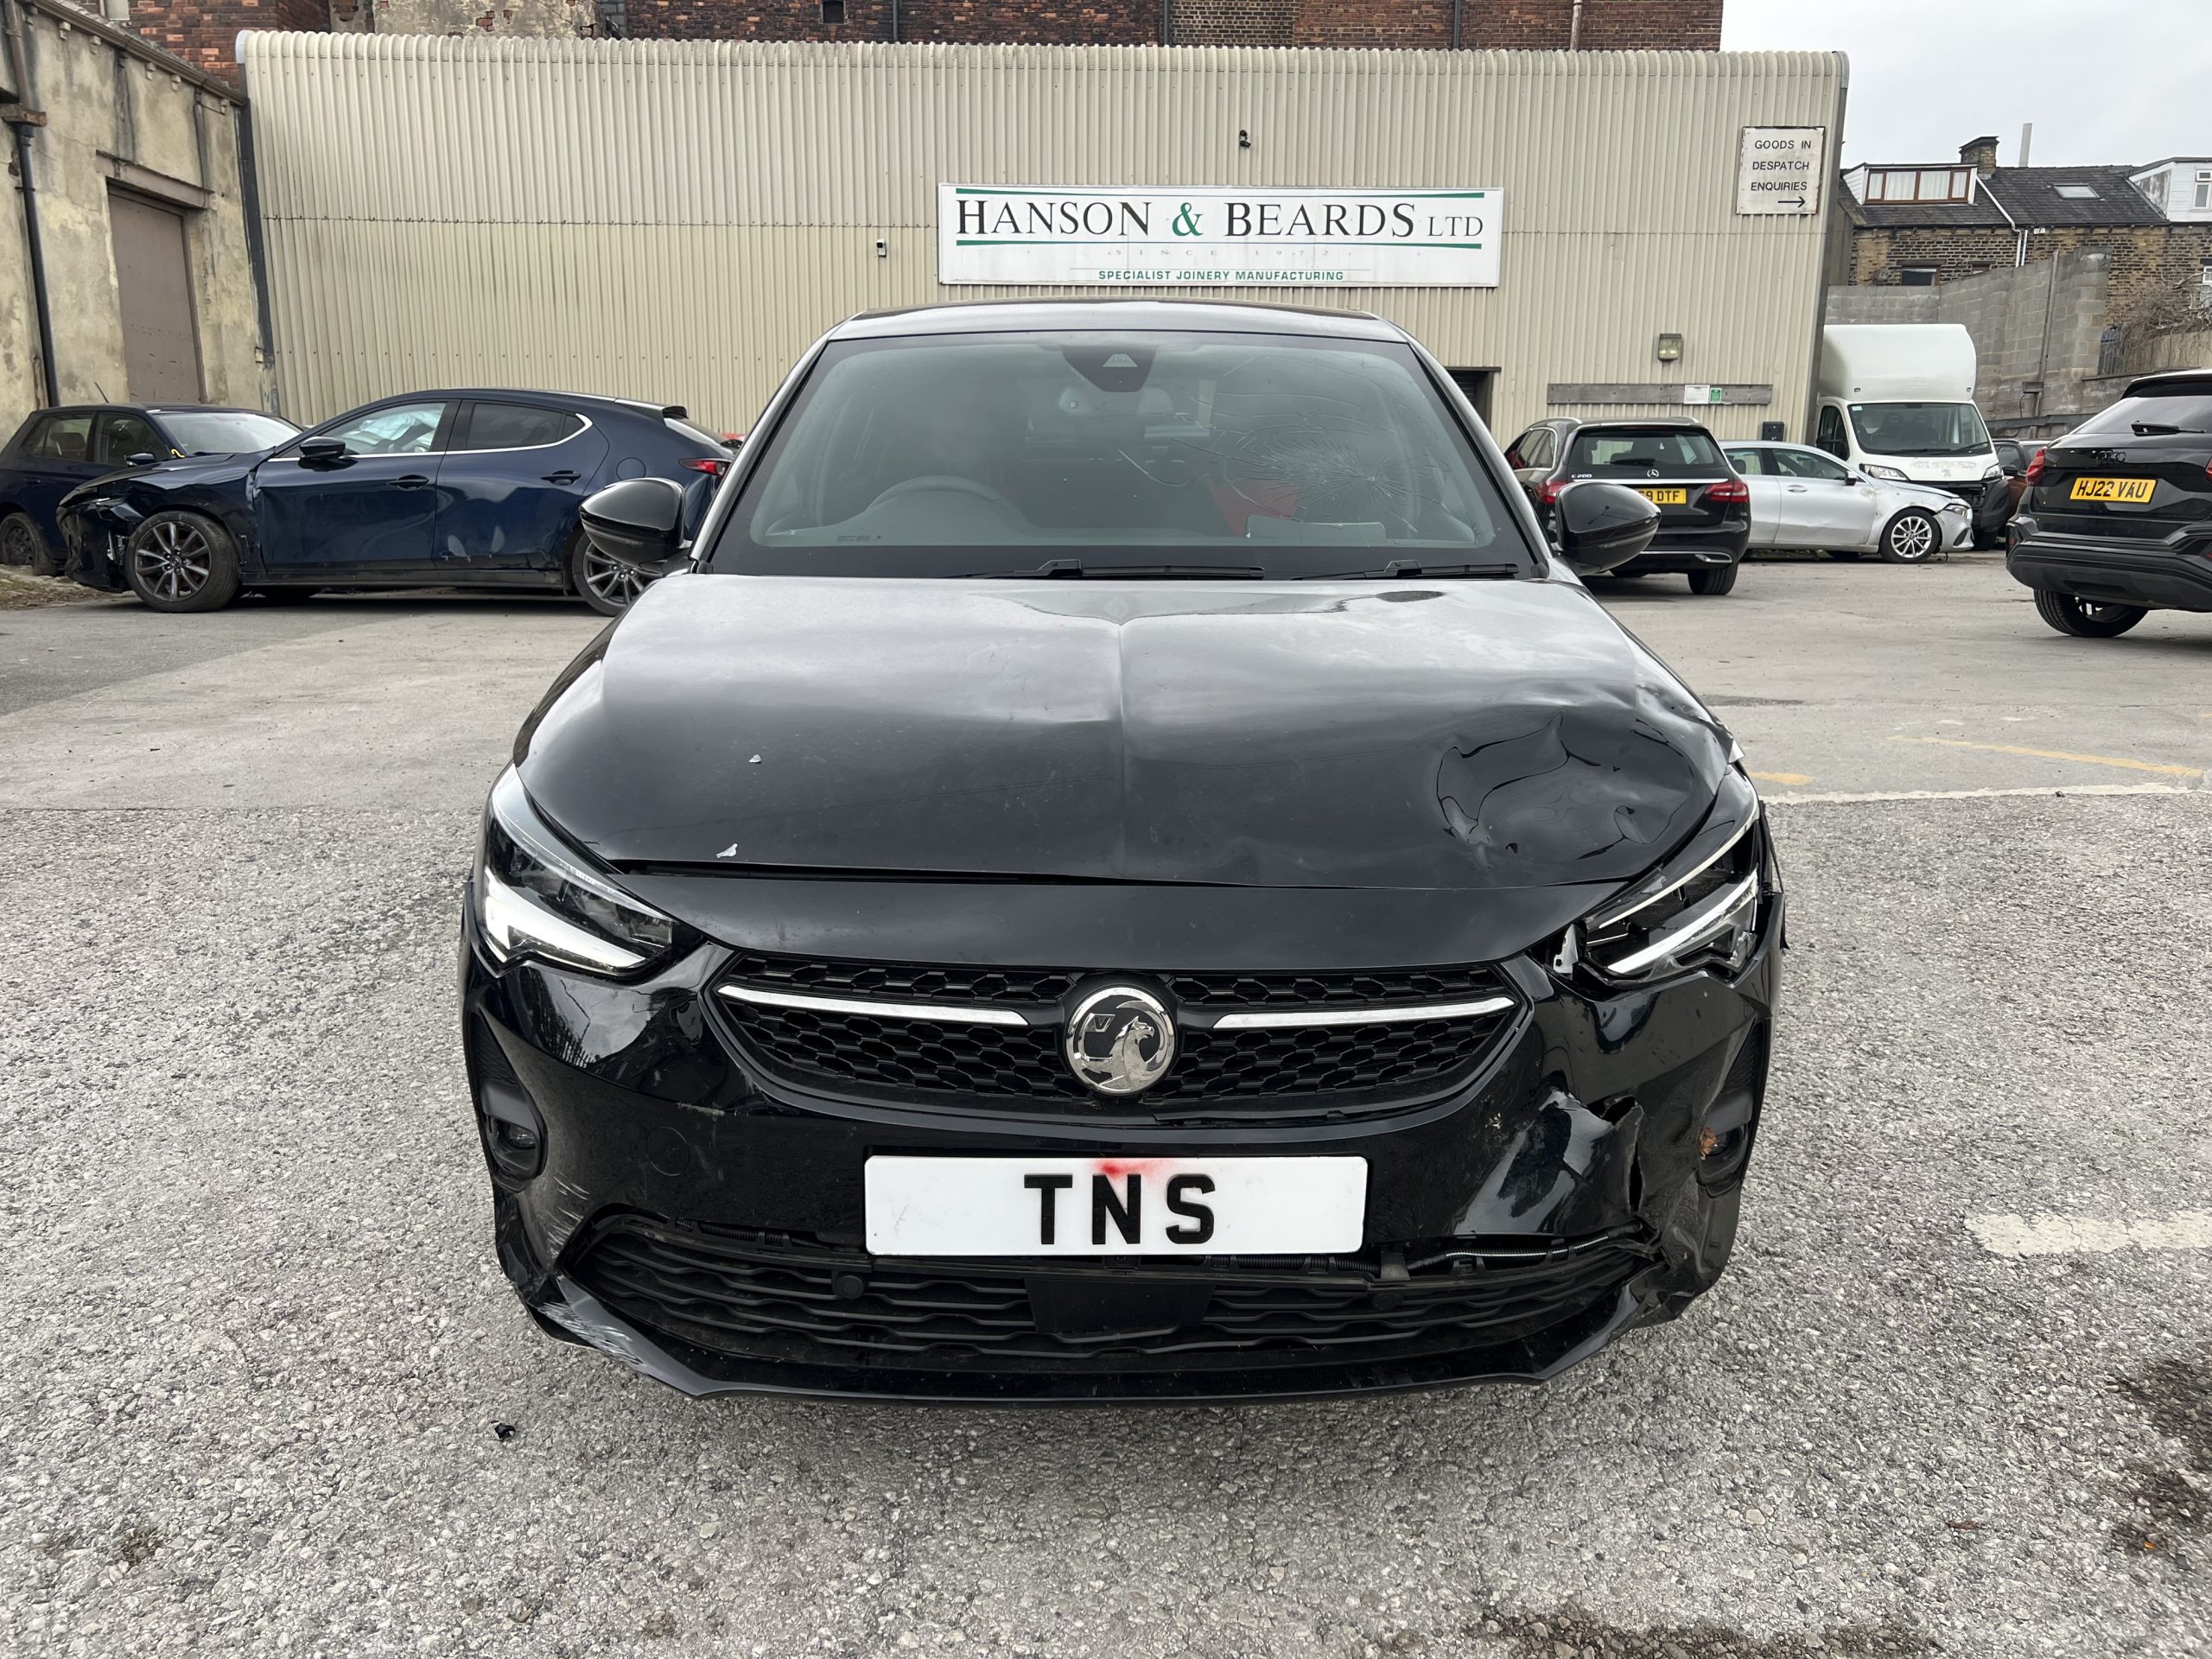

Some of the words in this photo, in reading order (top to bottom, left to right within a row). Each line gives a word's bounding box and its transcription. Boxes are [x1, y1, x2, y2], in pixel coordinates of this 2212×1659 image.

[1754, 140, 1795, 149] GOODS
[1801, 140, 1812, 149] IN
[1752, 161, 1809, 170] DESPATCH
[1751, 181, 1808, 191] ENQUIRIES
[956, 200, 1153, 236] HANSON
[1172, 202, 1204, 237] &
[1224, 202, 1415, 238] BEARDS
[1427, 216, 1484, 237] LTD
[1098, 270, 1171, 280] SPECIALIST
[1176, 270, 1230, 280] JOINERY
[1235, 270, 1344, 281] MANUFACTURING
[2075, 480, 2115, 497] HJ22
[2117, 481, 2148, 499] VAU
[1656, 490, 1681, 502] DTF
[1023, 1173, 1216, 1245] TNS
